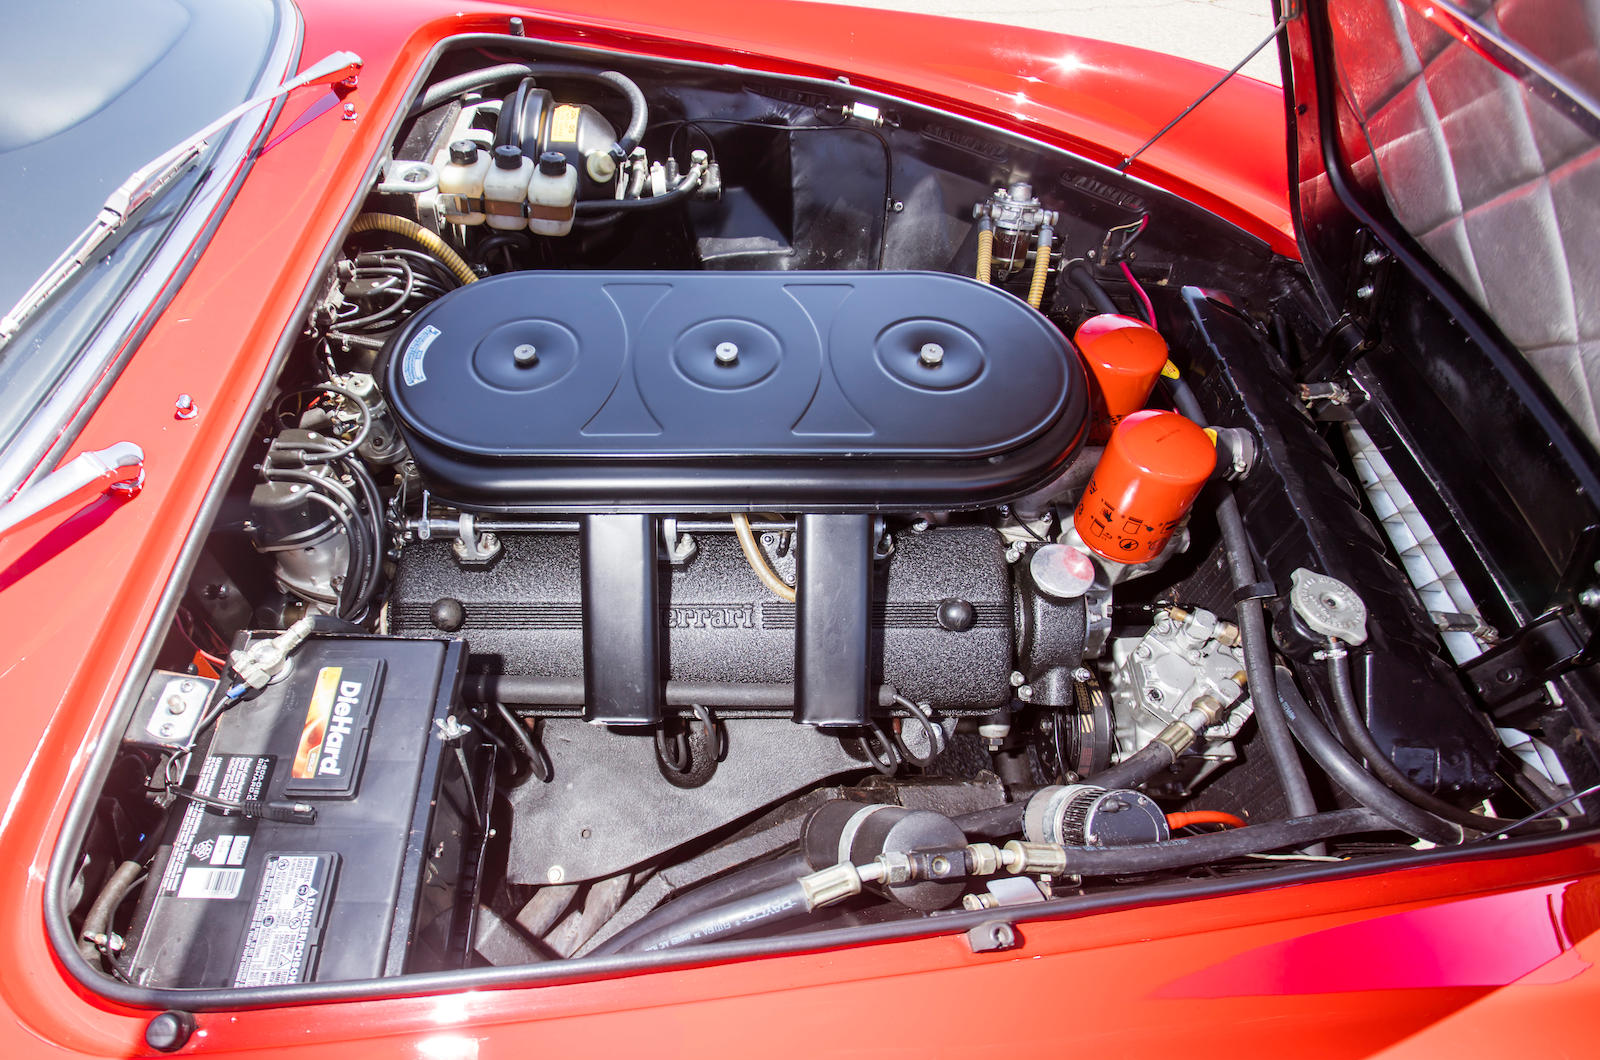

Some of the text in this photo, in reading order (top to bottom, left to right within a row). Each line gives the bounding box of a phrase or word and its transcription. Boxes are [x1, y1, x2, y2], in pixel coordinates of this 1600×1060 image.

[665, 603, 753, 629] errari
[318, 680, 362, 775] DieHard
[288, 898, 316, 983] DANGER/POISON
